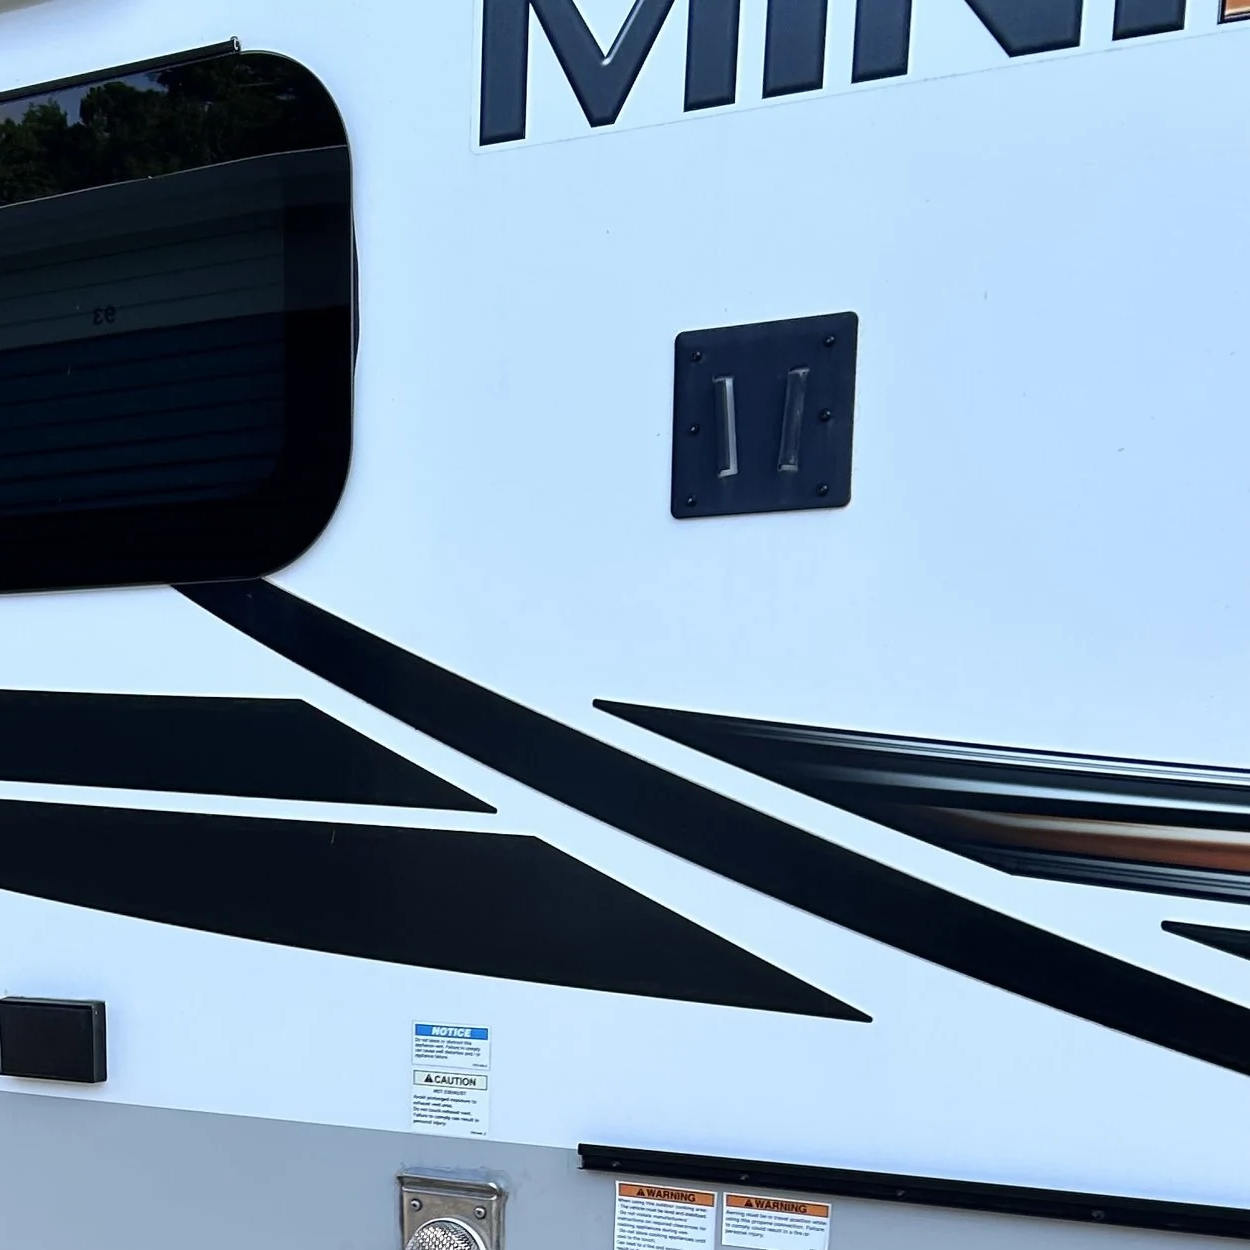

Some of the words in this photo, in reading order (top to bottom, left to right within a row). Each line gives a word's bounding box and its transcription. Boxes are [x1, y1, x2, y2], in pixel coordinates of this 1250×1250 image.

[432, 1027, 471, 1037] NOTICE
[435, 1075, 476, 1086] CAUTION
[647, 1189, 696, 1202] WARNING
[755, 1200, 807, 1213] WARNING
